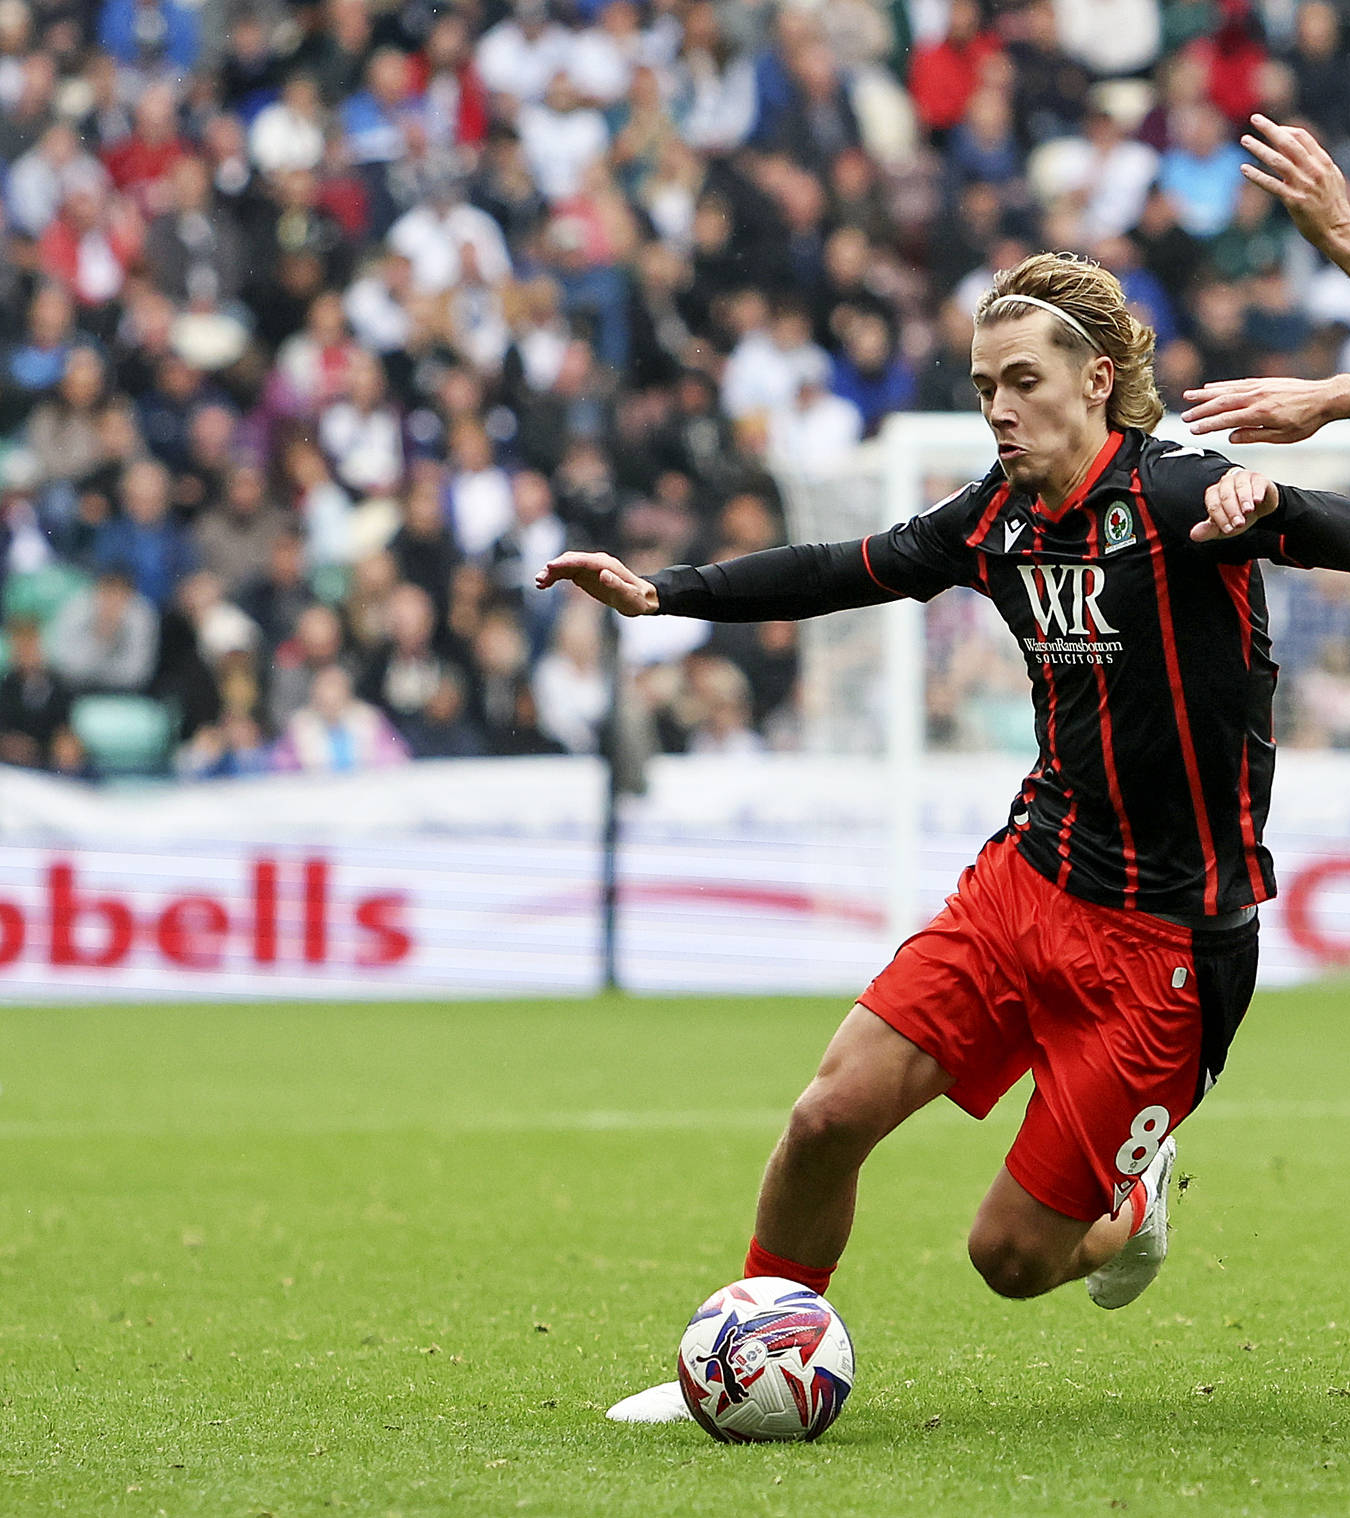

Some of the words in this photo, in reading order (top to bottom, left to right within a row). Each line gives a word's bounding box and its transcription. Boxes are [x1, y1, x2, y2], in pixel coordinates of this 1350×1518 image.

[1017, 565, 1120, 636] WR
[1035, 653, 1114, 665] SOLICITORS
[1115, 1105, 1170, 1175] 8
